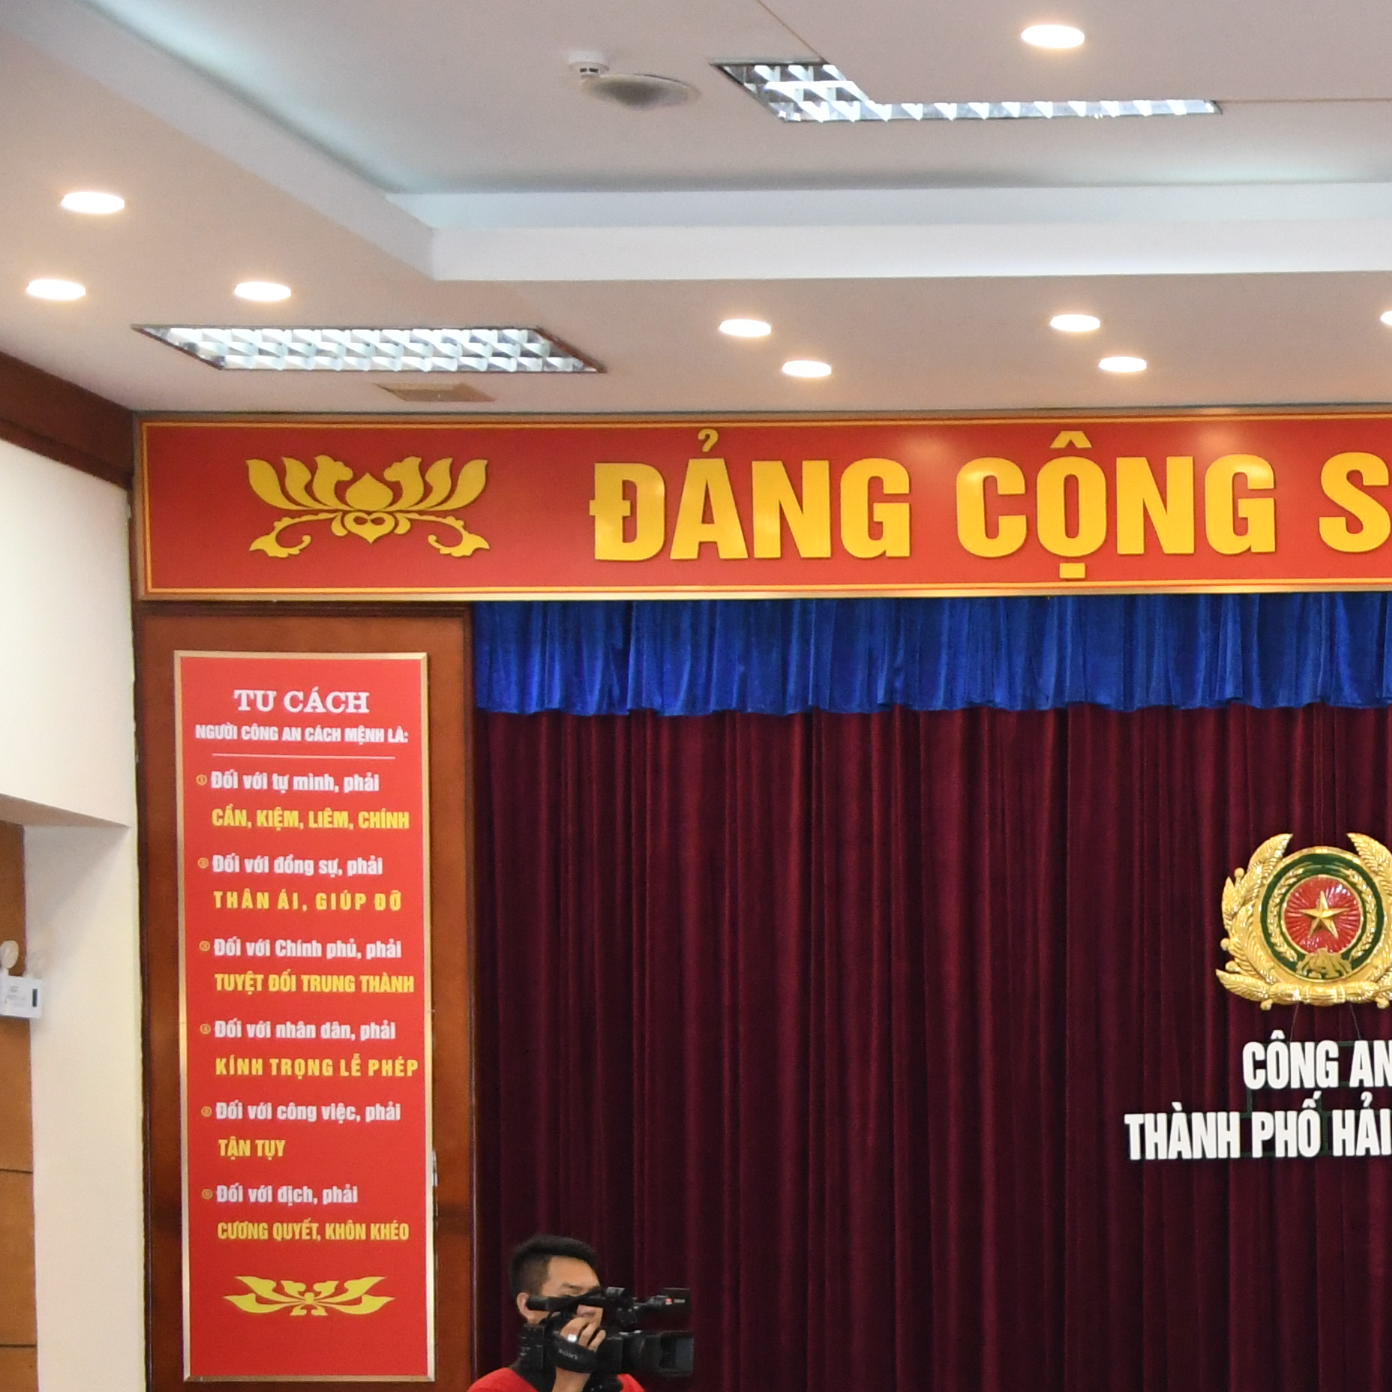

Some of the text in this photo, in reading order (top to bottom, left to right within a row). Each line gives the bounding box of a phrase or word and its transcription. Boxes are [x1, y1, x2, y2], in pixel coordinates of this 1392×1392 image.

[589, 429, 910, 561] ĐẢNG
[956, 430, 1275, 578] CỘNG
[284, 687, 369, 713] CÁCH
[195, 723, 408, 744] NGƯỜI CÔNG AN CÁCH MỆNH LÀ:
[210, 770, 239, 789] Đối
[243, 771, 268, 789] với
[272, 773, 289, 793] tự
[293, 773, 339, 792] mình,
[343, 773, 379, 793] phải
[256, 807, 304, 830] KIỆM,
[308, 808, 353, 830] LIÊM,
[358, 809, 410, 829] CHÍNH
[212, 853, 240, 873] Đối
[244, 856, 269, 873] với
[319, 857, 343, 877] sự,
[347, 856, 383, 876] phải
[213, 889, 269, 909] THÂN
[277, 890, 307, 912] ÁI,
[315, 890, 366, 910] GIÚP
[213, 936, 242, 957] Đối
[246, 939, 271, 957] với
[275, 939, 322, 958] Chính
[326, 938, 361, 959] phủ,
[366, 937, 402, 959] phải
[1242, 1030, 1340, 1090] CÔNG
[1124, 1102, 1241, 1161] THÀNH
[1251, 1091, 1322, 1158] PHỐ
[1332, 1092, 1392, 1156] HẢI
